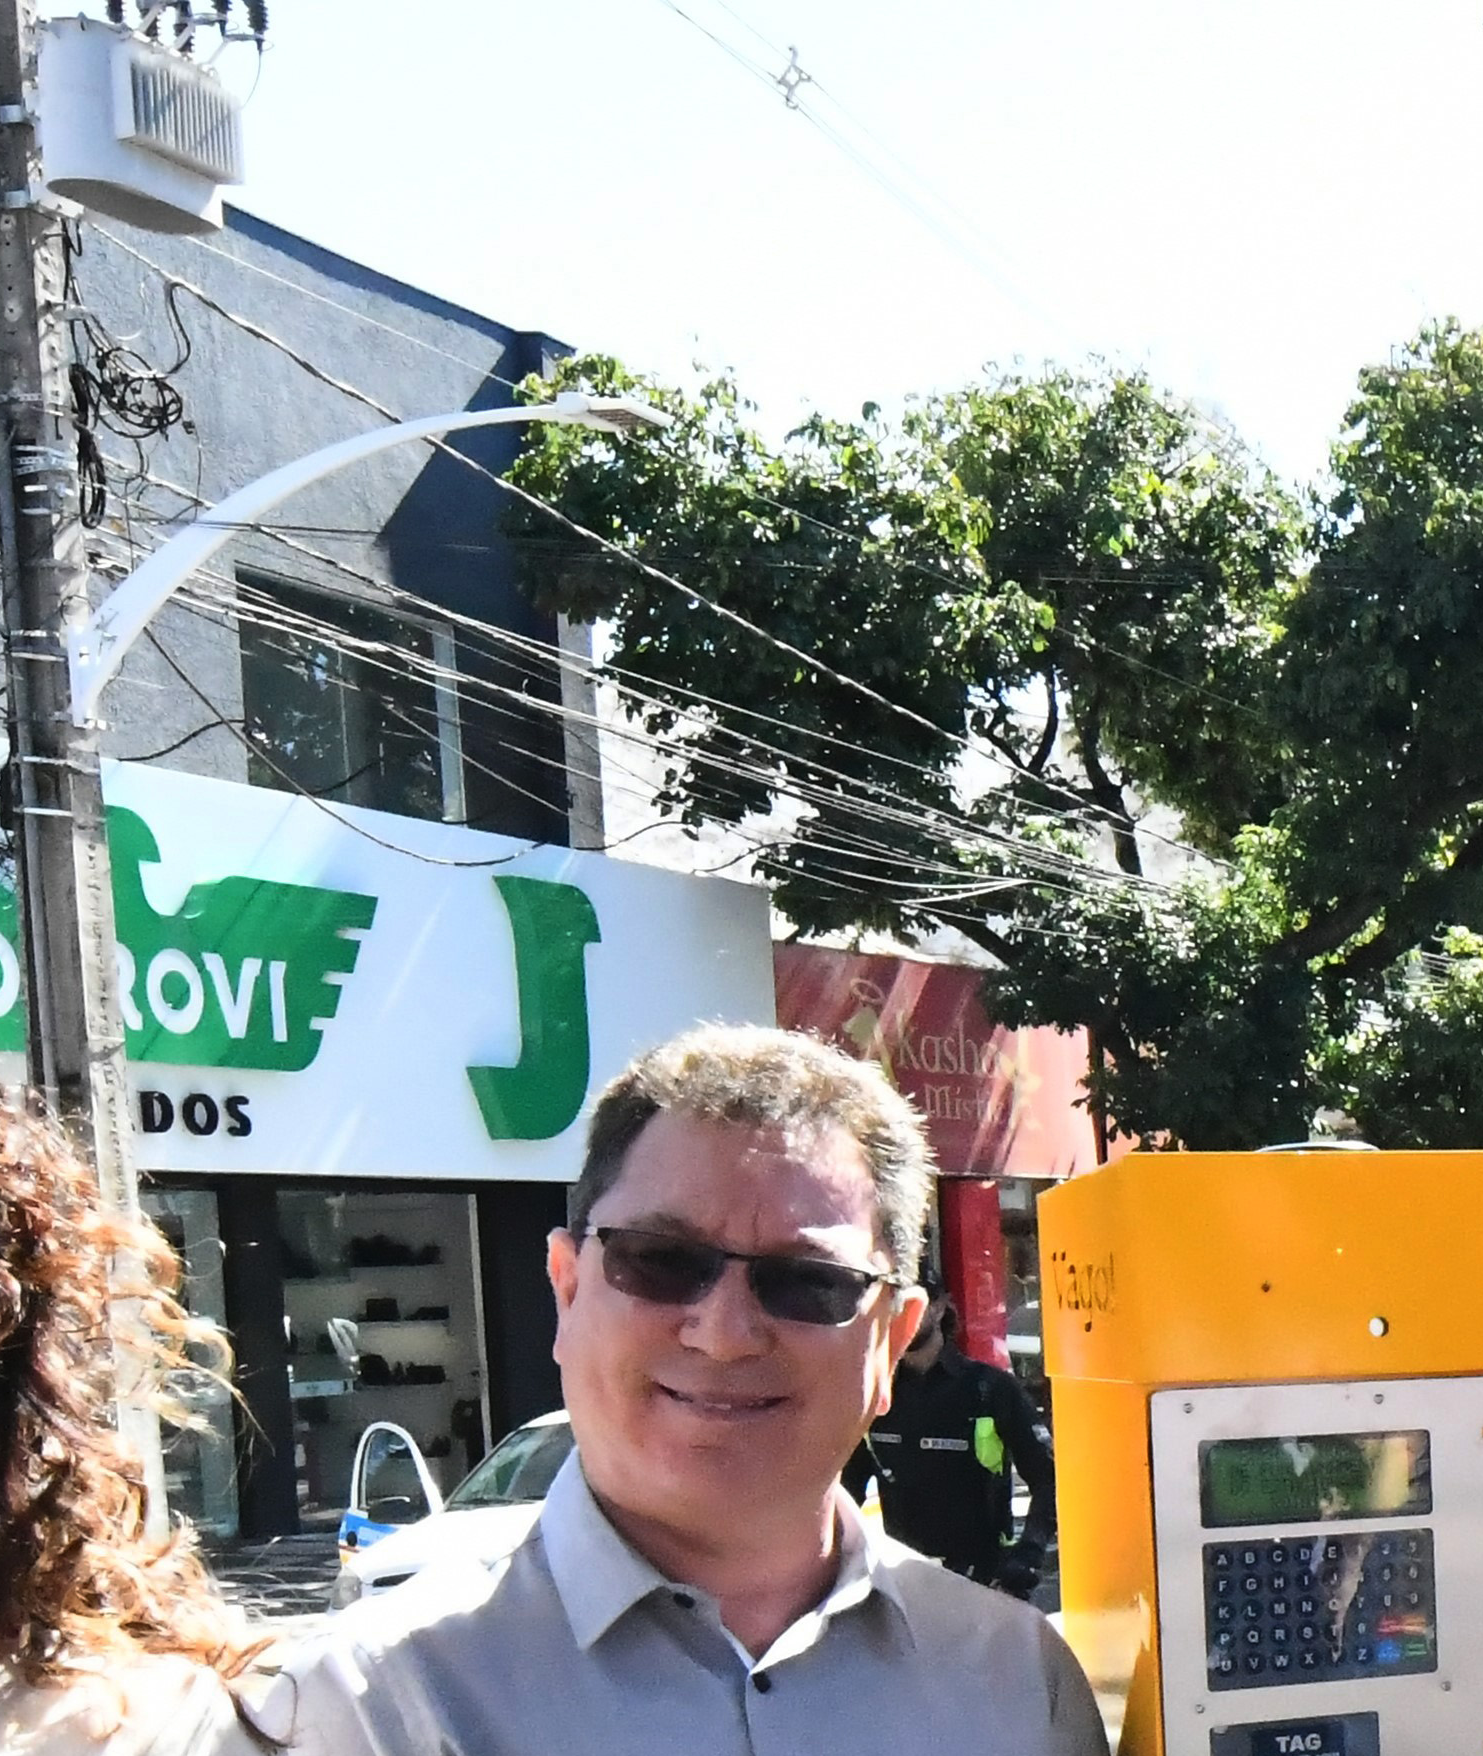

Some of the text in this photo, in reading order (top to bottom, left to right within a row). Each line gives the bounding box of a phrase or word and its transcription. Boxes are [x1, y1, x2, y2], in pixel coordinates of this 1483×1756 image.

[1217, 1554, 1228, 1565] A
[1244, 1551, 1255, 1564] B
[1273, 1550, 1283, 1562] C
[1300, 1548, 1310, 1560] D
[1328, 1546, 1337, 1558] E
[1219, 1580, 1227, 1592] F
[1246, 1578, 1257, 1590] G
[1274, 1577, 1284, 1588] H
[1218, 1606, 1230, 1618] K
[1247, 1606, 1256, 1617] L
[1274, 1603, 1285, 1614] M
[1302, 1601, 1312, 1612] N
[1220, 1633, 1230, 1645] P
[1247, 1630, 1259, 1643] Q
[1275, 1629, 1285, 1640] R
[1302, 1627, 1313, 1639] S
[1221, 1659, 1232, 1671] U
[1249, 1658, 1259, 1669] V
[1275, 1655, 1289, 1667] W
[1304, 1653, 1314, 1664] X
[1358, 1649, 1367, 1660] Z
[1275, 1733, 1322, 1753] TAG
